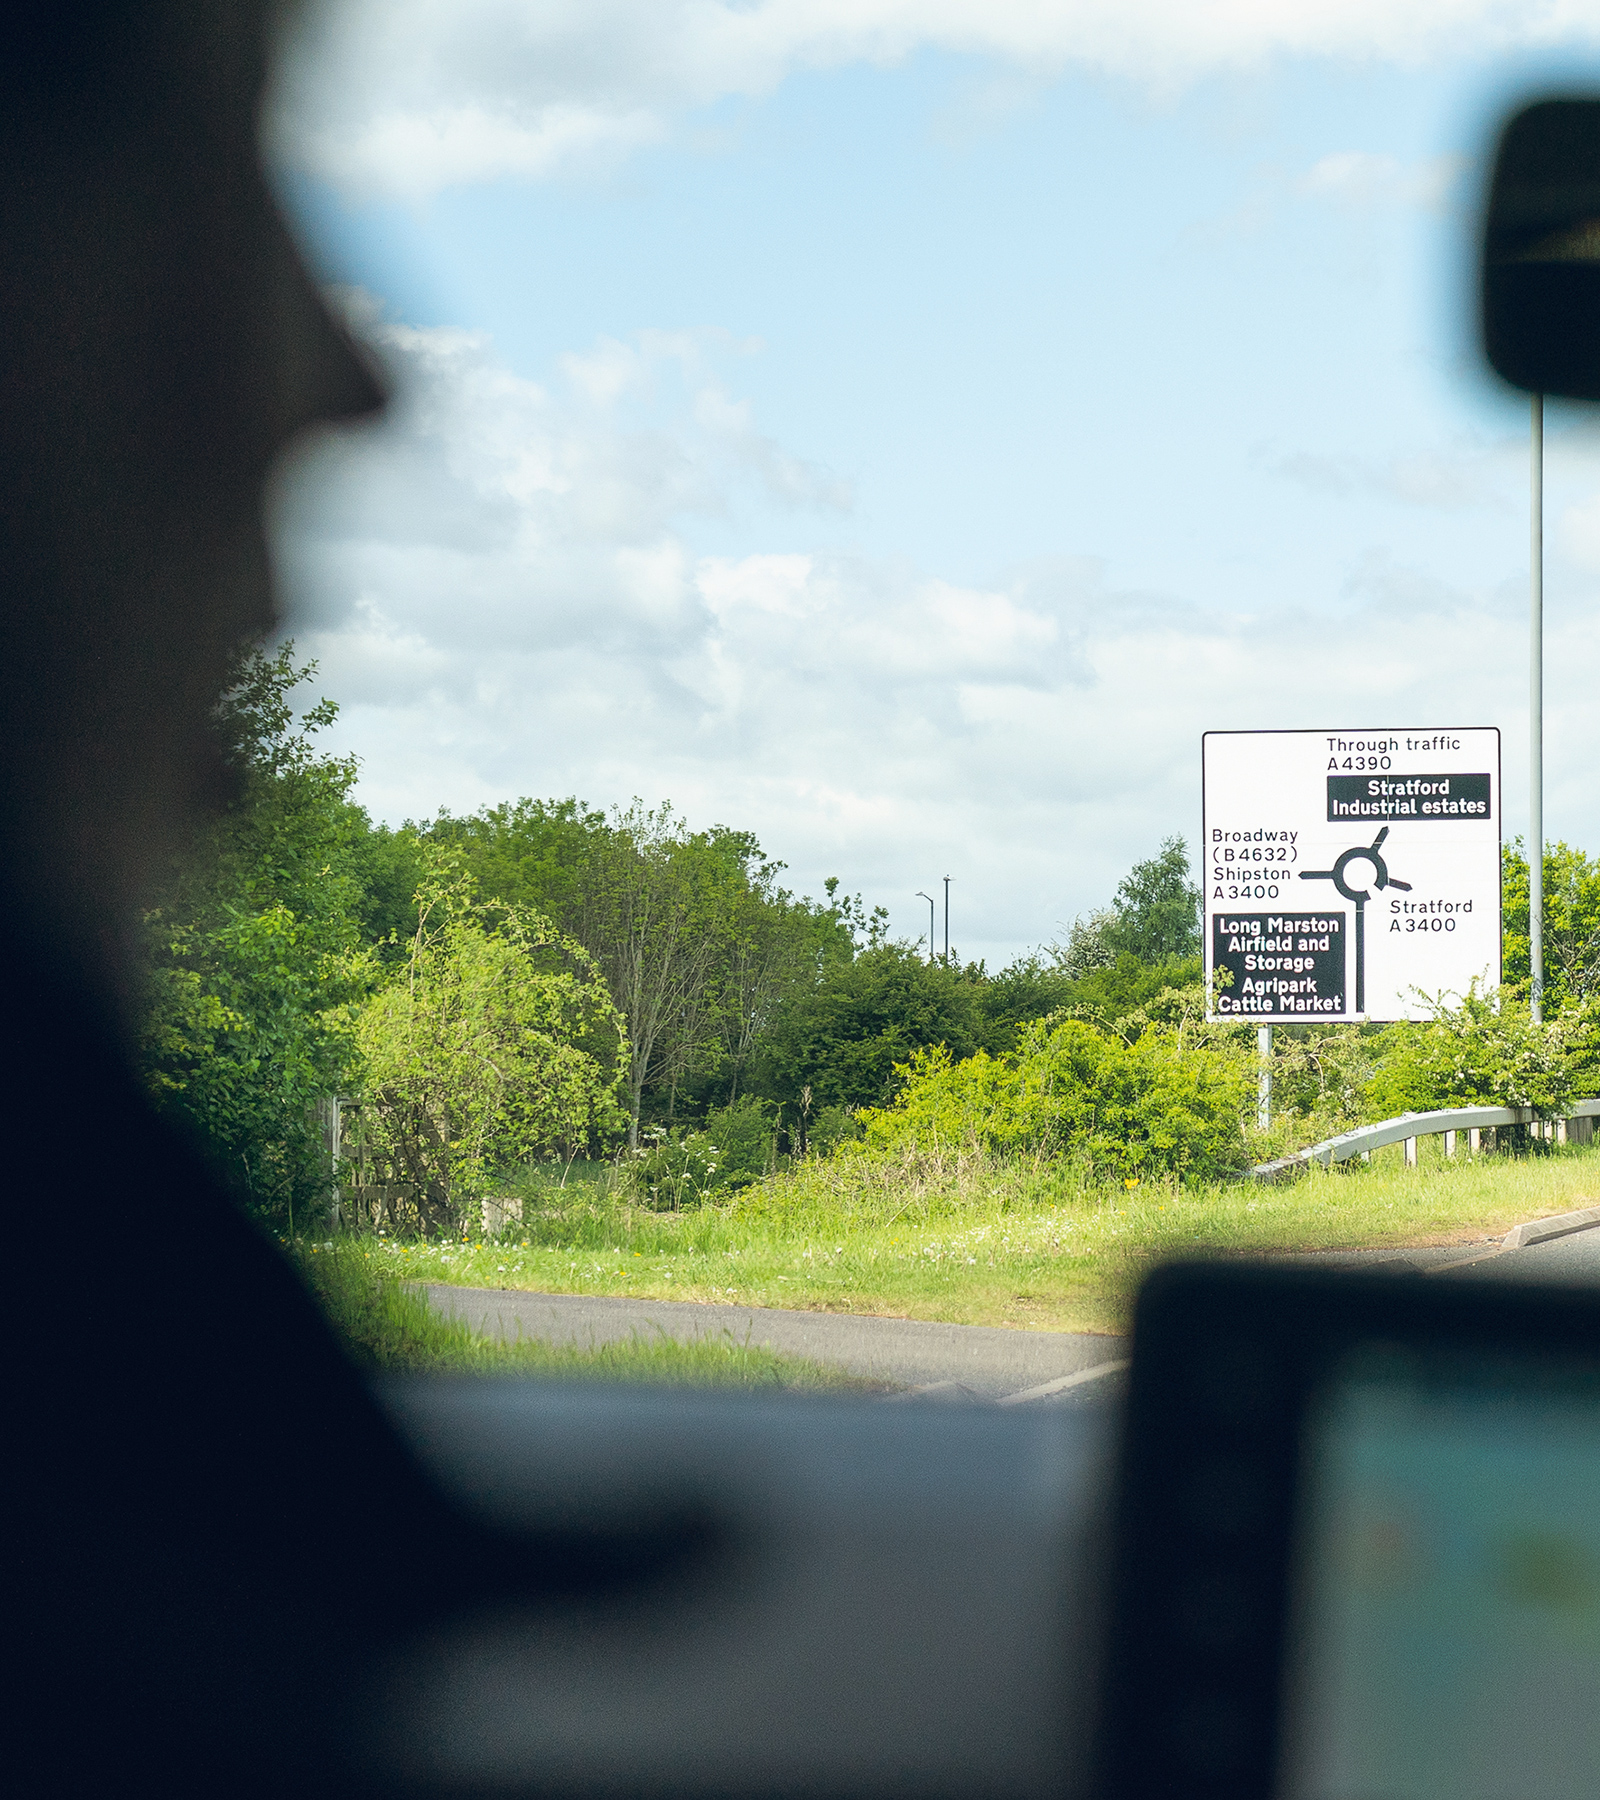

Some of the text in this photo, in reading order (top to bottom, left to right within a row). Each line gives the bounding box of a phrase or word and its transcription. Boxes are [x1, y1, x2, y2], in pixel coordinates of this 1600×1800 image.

[1326, 736, 1460, 754] Through traffic
[1327, 755, 1392, 771] A4390
[1367, 778, 1450, 796] Stratford
[1333, 797, 1486, 816] Industrial estates
[1212, 828, 1298, 845] Broadway
[1212, 845, 1298, 864] (B4632)
[1213, 866, 1291, 883] Shipston
[1213, 884, 1279, 900] A3400
[1390, 899, 1473, 914] Stratford
[1220, 916, 1339, 937] Long Marston
[1389, 917, 1456, 933] A3400
[1228, 934, 1330, 952] Airfield and
[1244, 954, 1315, 973] Storage
[1241, 976, 1317, 996] Agripark
[1219, 995, 1342, 1013] Cattle Market
